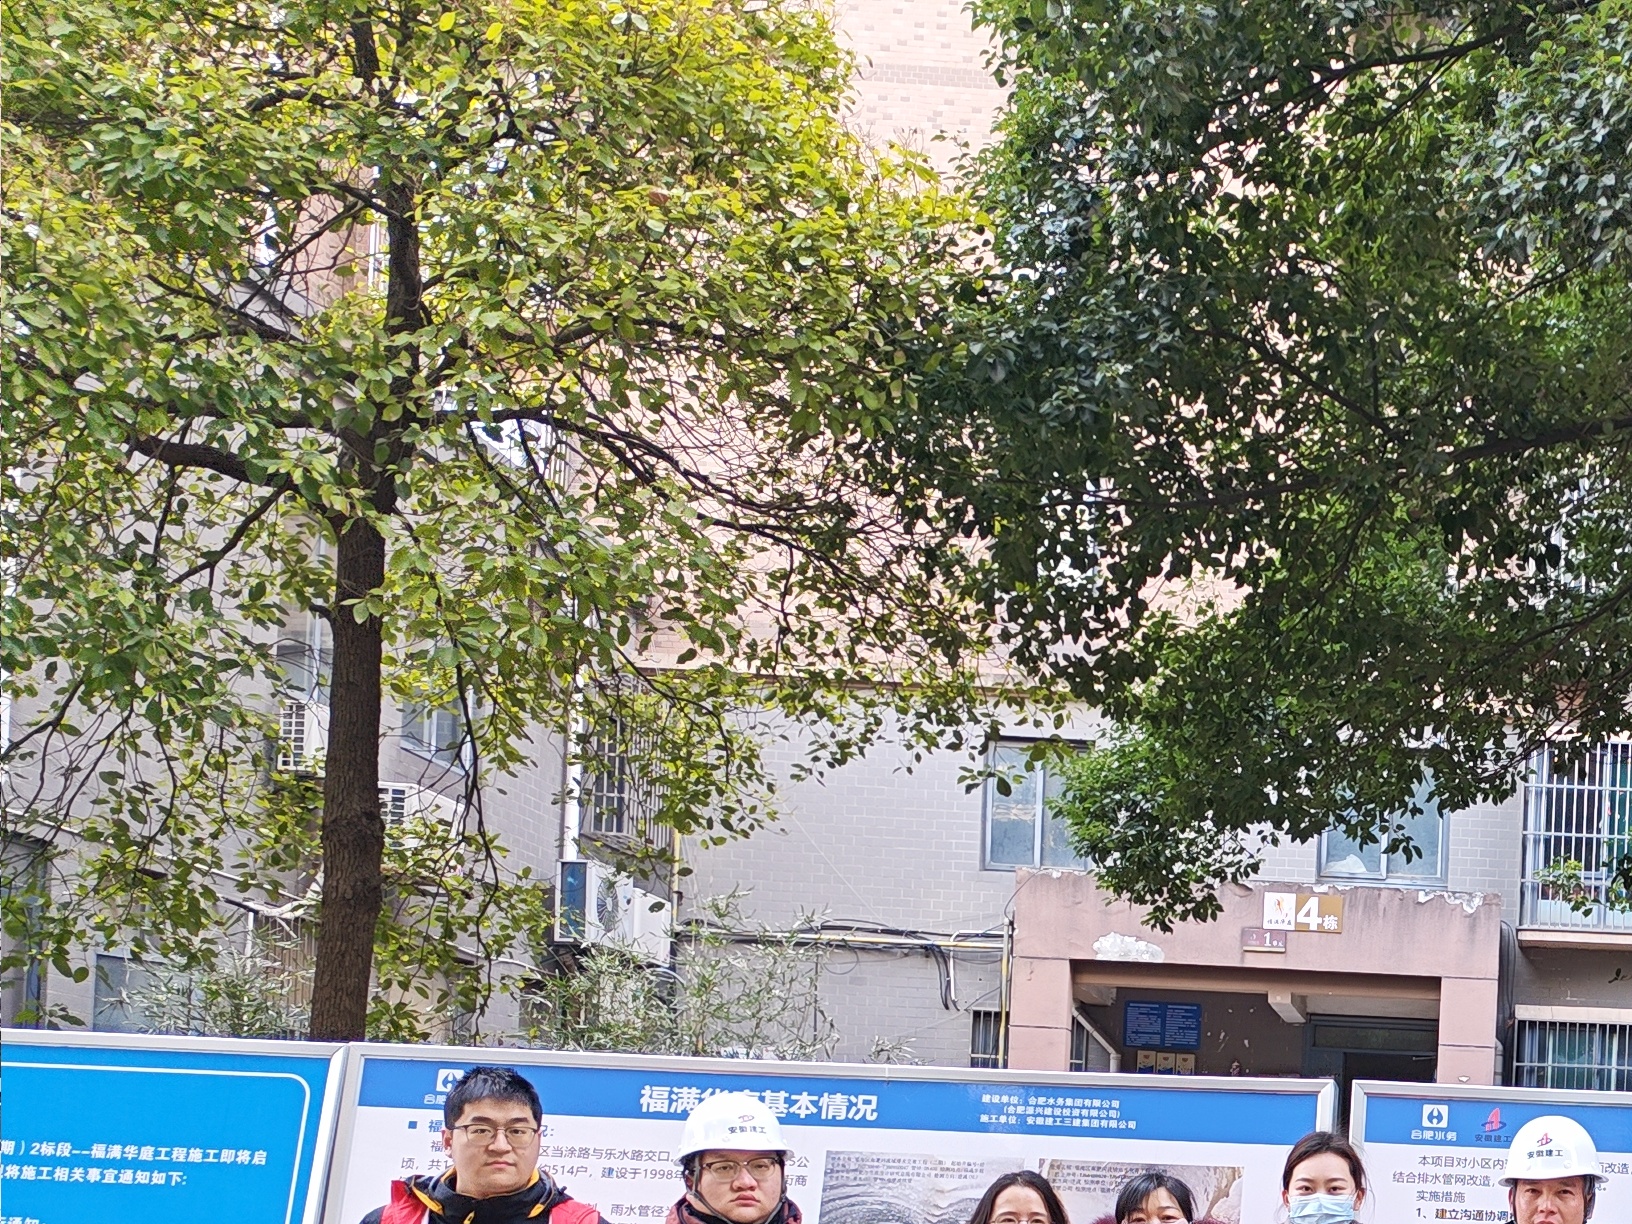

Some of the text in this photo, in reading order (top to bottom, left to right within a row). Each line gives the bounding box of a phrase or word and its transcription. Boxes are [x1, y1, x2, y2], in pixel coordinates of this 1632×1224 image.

[1296, 896, 1339, 931] 4栋
[640, 1085, 879, 1122] 福满基本情况
[1410, 1129, 1458, 1142] 合肥水务
[1418, 1154, 1509, 1170] 本项目对小区内
[1416, 1190, 1466, 1203] 实施措施
[1416, 1208, 1514, 1222] 1、建立沟通协调
